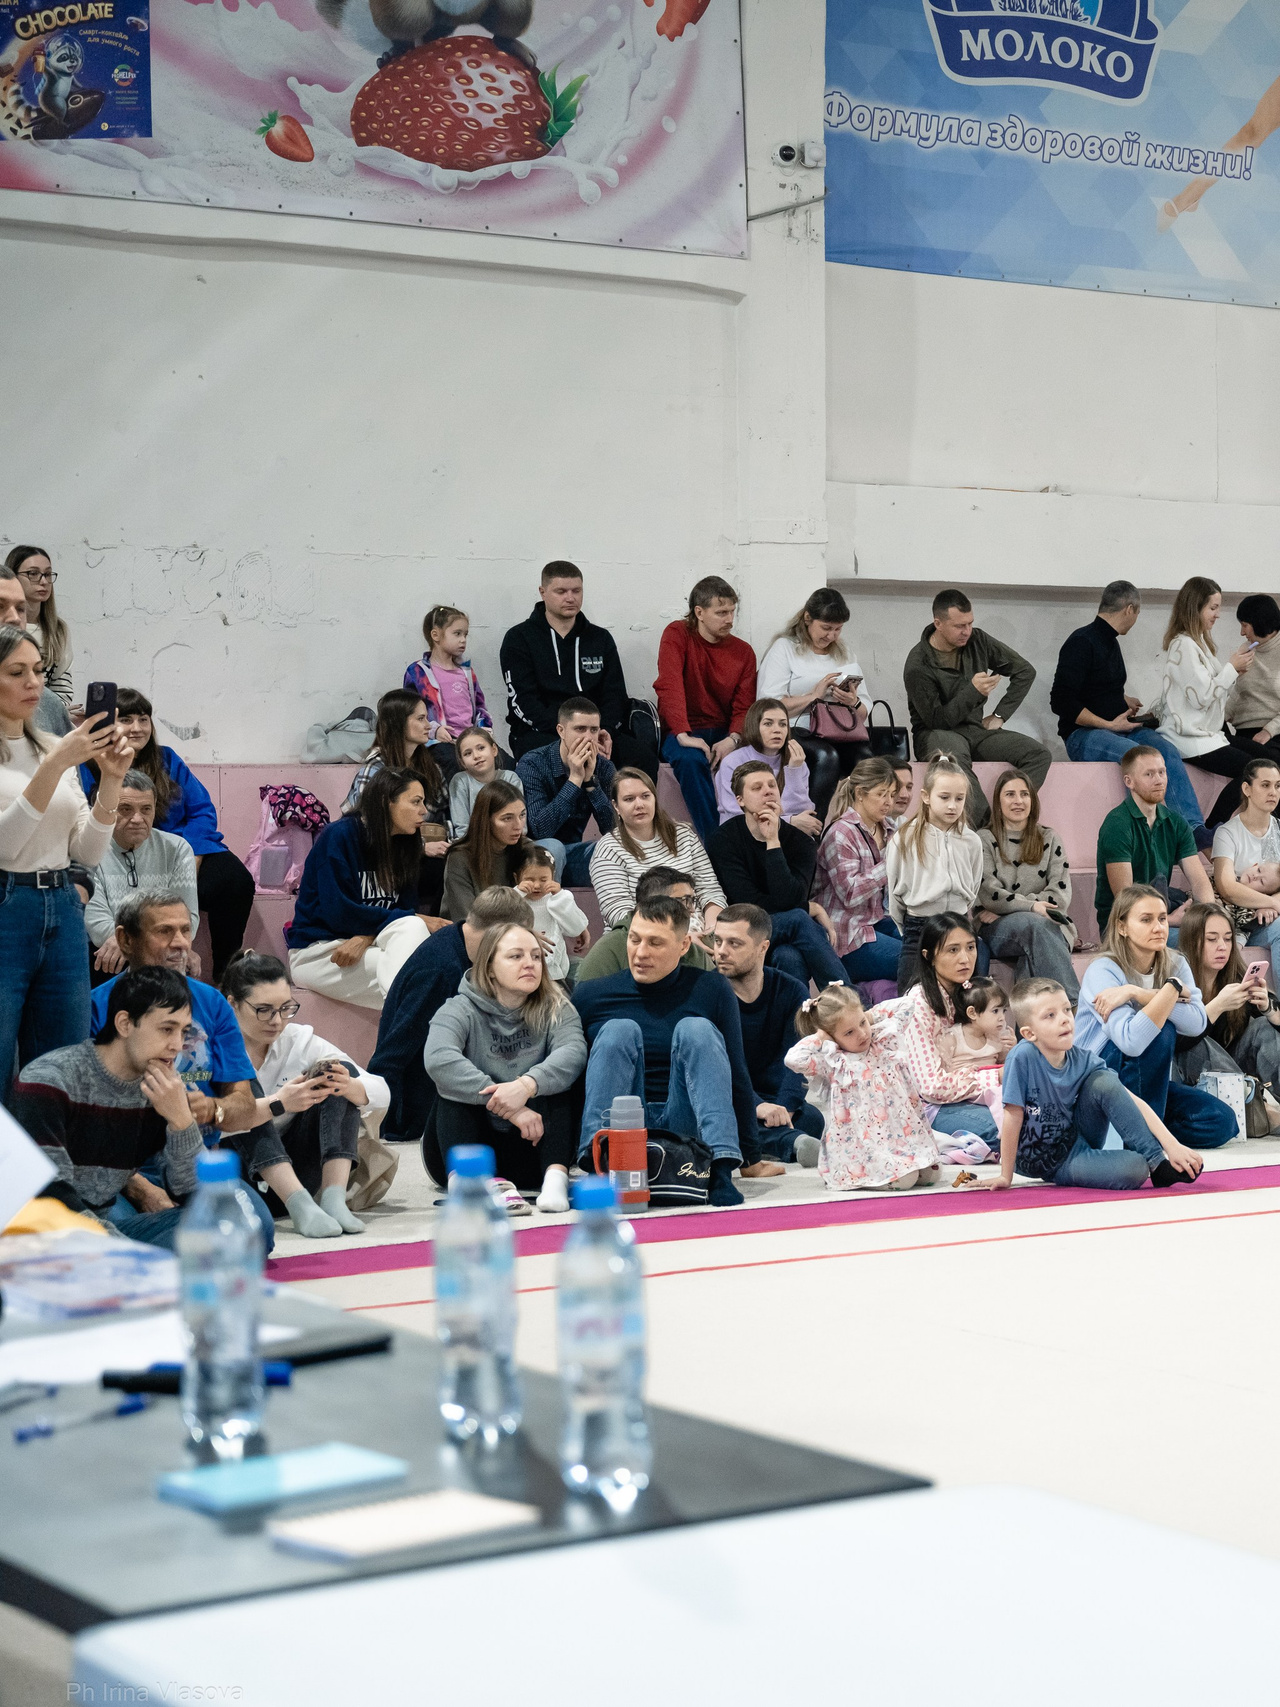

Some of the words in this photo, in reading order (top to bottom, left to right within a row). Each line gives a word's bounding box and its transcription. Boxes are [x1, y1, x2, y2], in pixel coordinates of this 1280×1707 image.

[15, 3, 114, 38] CHOCOLATE
[959, 28, 1134, 83] МОЛОКО
[824, 91, 981, 149] Формула
[986, 114, 1140, 163] здоровой
[1145, 143, 1255, 181] жизни!
[490, 1040, 532, 1053] CAMPUS
[491, 1029, 530, 1043] WINTER
